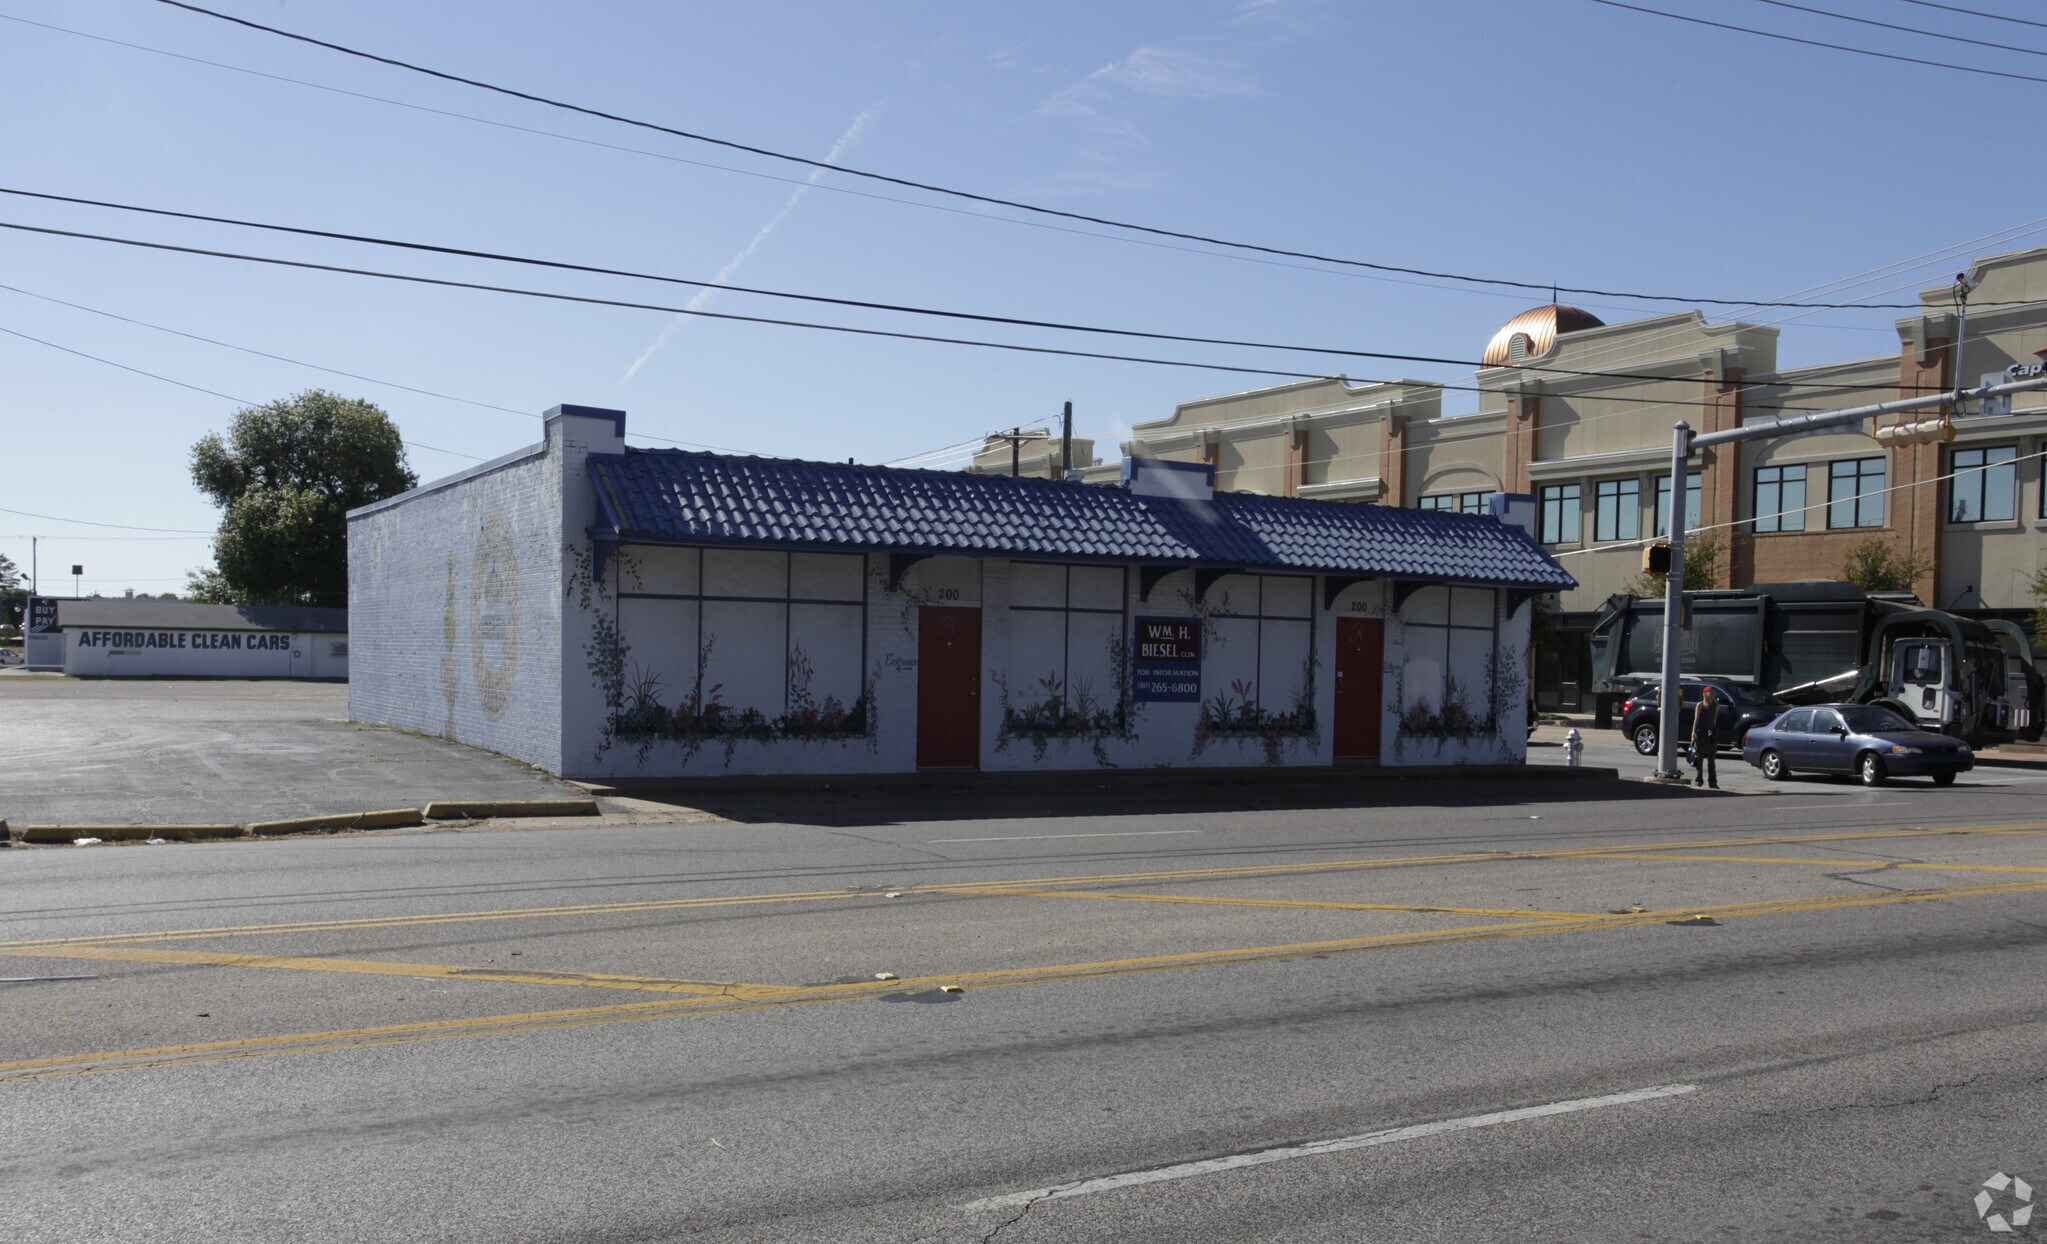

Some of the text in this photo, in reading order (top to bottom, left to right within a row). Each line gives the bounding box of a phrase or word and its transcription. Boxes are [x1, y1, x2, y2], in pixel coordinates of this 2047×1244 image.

[2007, 363, 2046, 377] Cap
[938, 588, 960, 600] 200
[35, 606, 55, 614] BUY
[1351, 601, 1368, 612] 200
[35, 617, 55, 625] PAY
[1179, 626, 1191, 640] H.
[78, 631, 290, 651] AFFORDABLE CLEAN CARS
[1141, 643, 1179, 658] BIESEL
[1136, 668, 1199, 677] FOR INFORMATION
[1151, 682, 1198, 693] 265-6800
